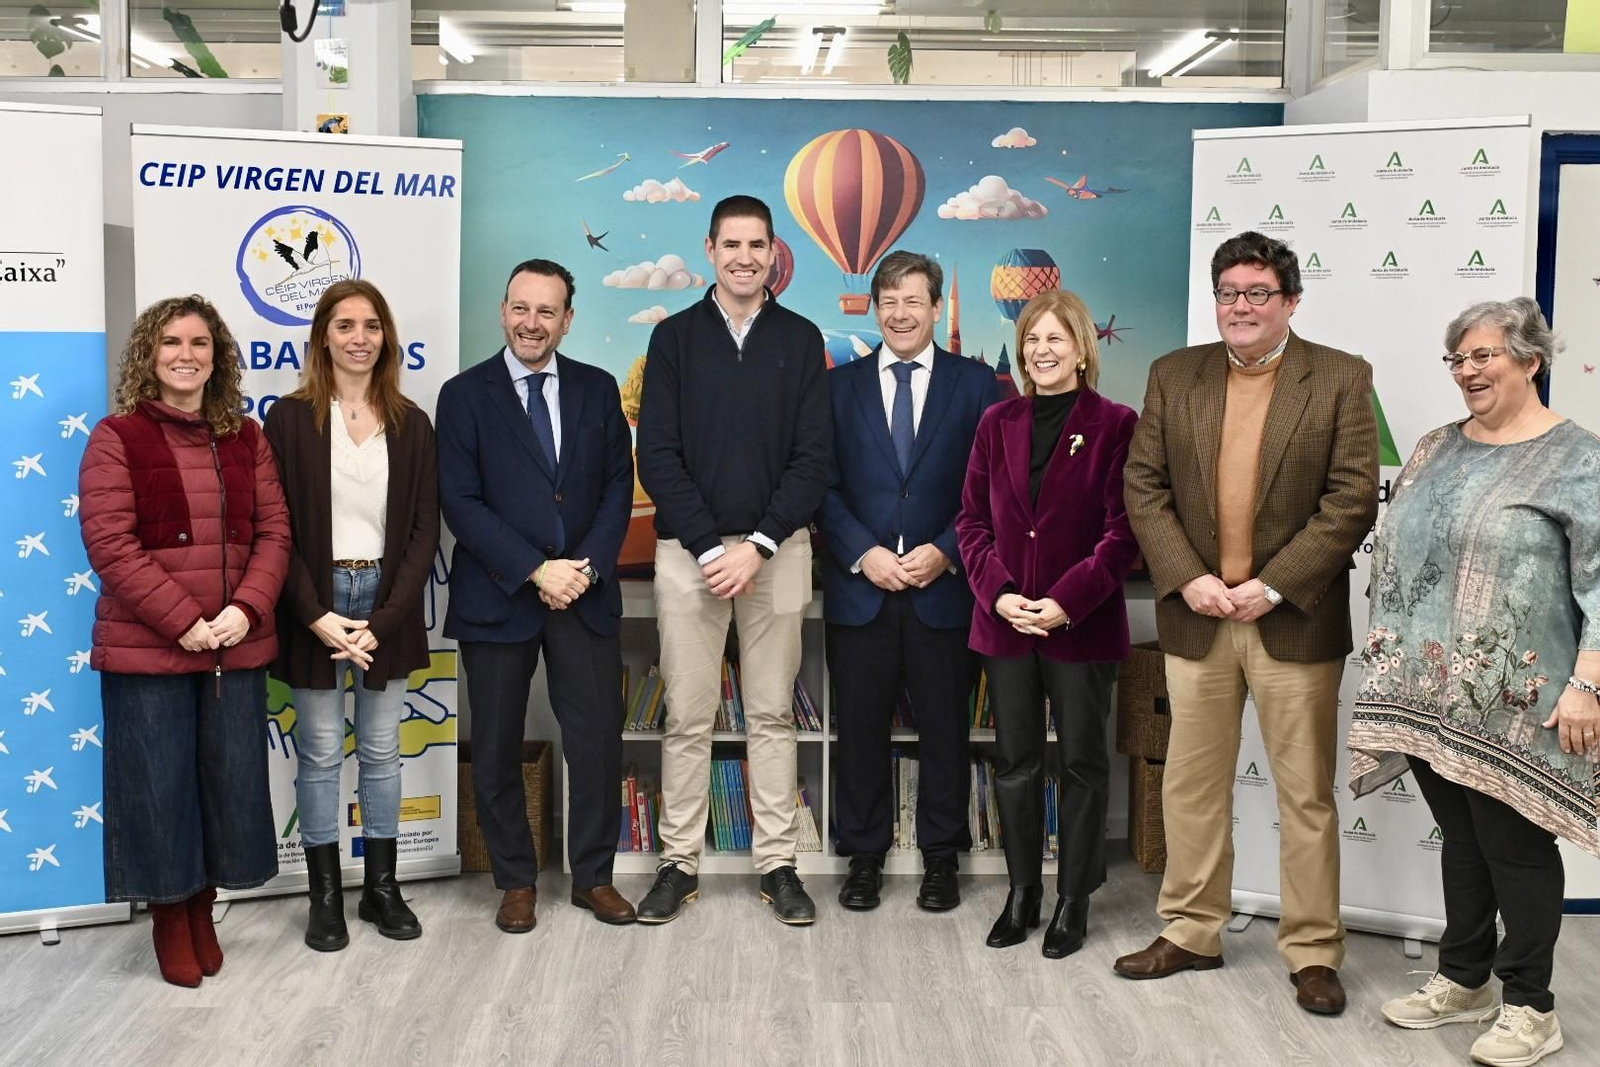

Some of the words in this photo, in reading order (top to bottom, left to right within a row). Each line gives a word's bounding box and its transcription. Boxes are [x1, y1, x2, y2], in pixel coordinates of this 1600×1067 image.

[139, 162, 206, 188] CEIP
[216, 165, 325, 194] VIRGEN
[333, 170, 384, 195] DEL
[393, 172, 456, 198] MAR
[265, 283, 297, 296] CEIP
[280, 292, 307, 303] DEL
